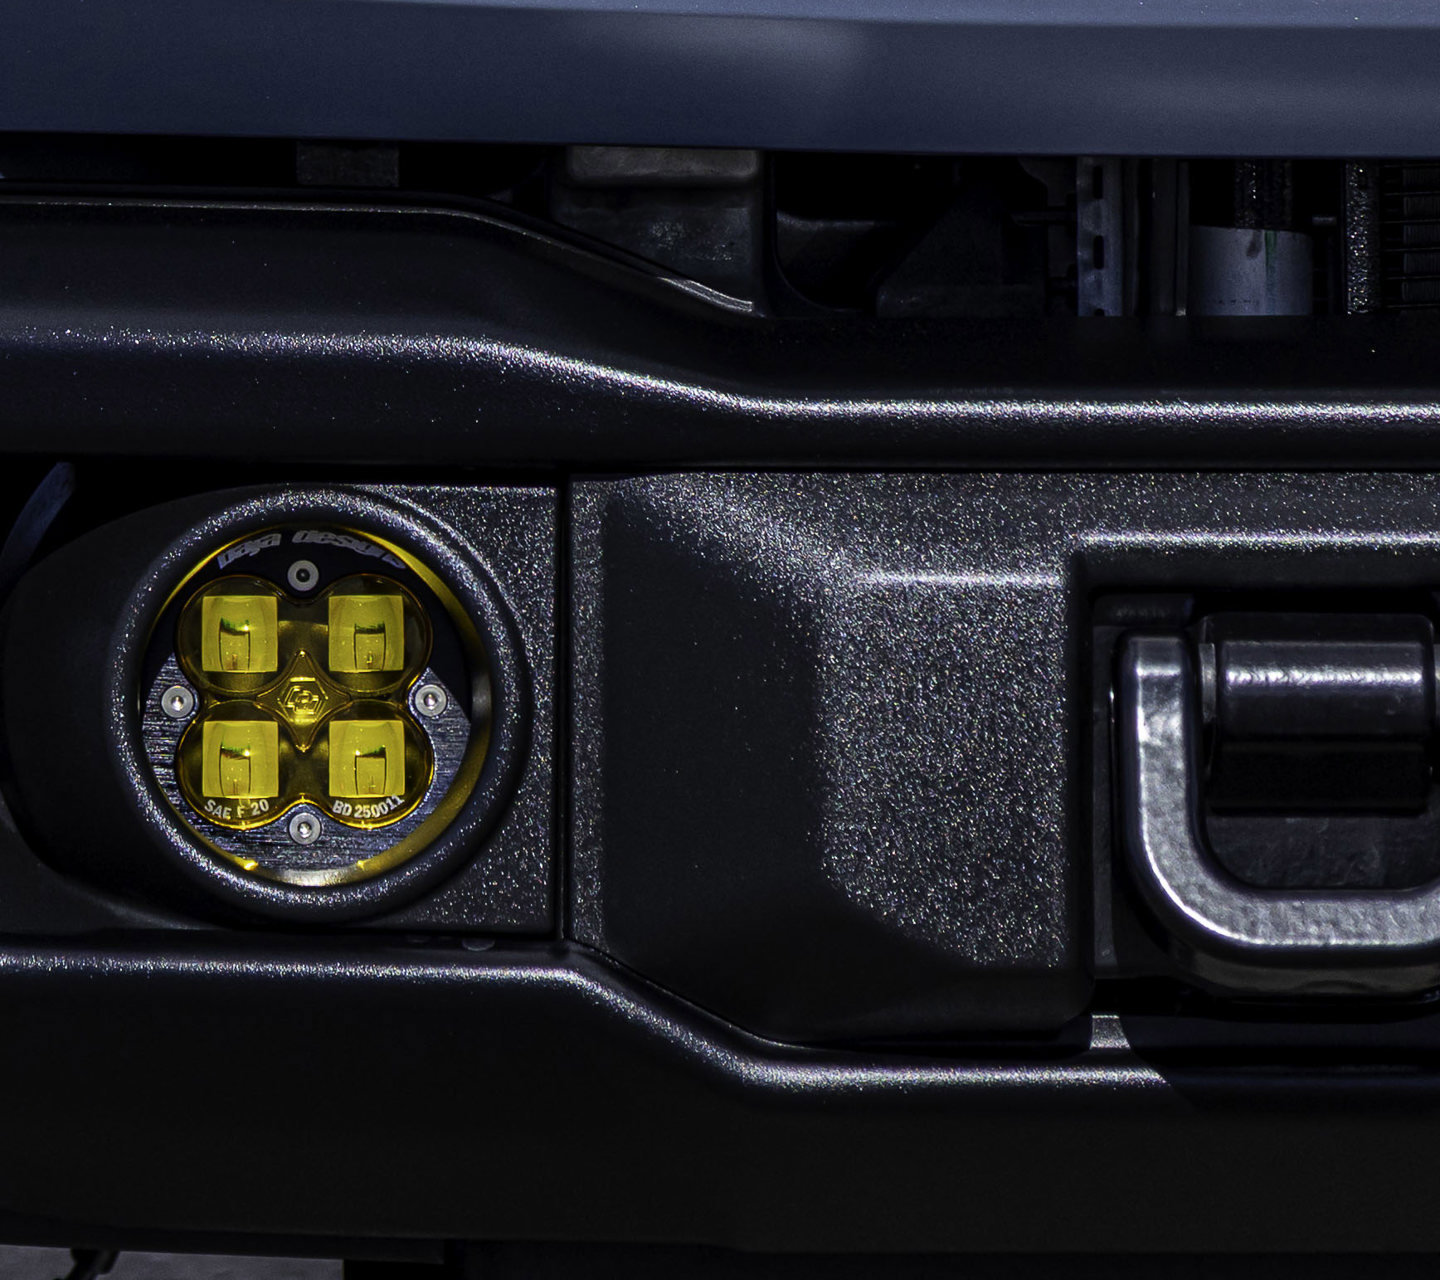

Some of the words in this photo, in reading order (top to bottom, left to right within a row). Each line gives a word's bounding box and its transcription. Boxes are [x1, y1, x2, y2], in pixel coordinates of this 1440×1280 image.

[204, 799, 232, 820] SAE
[237, 805, 245, 818] F
[251, 798, 269, 816] 20
[332, 799, 352, 816] BD
[354, 794, 406, 819] 250011
